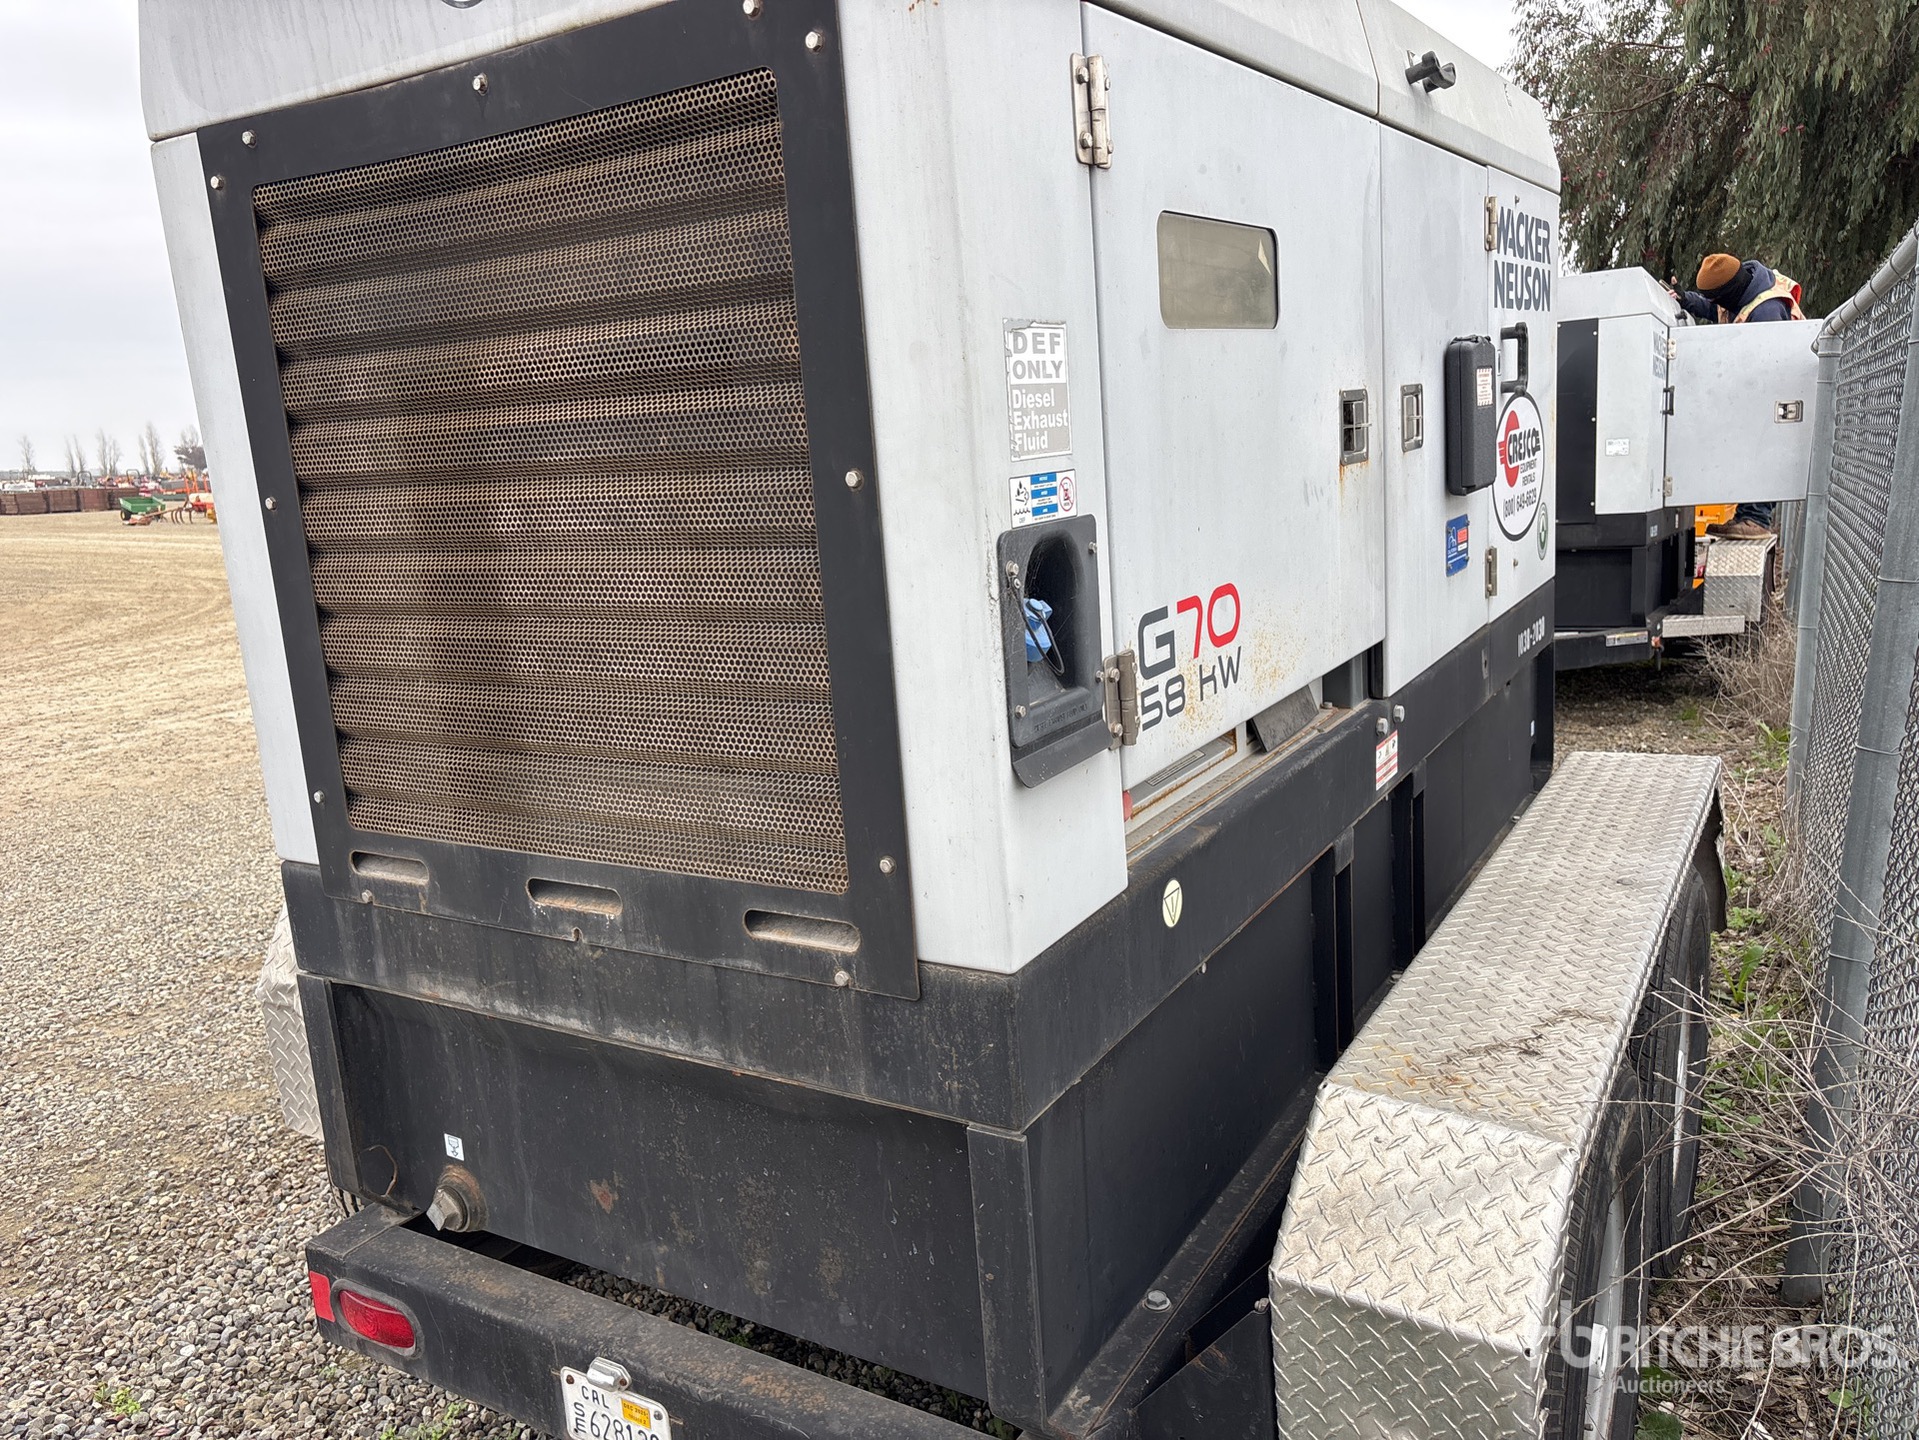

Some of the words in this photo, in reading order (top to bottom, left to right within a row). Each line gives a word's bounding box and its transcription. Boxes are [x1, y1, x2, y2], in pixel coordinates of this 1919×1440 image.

[1497, 206, 1551, 264] WACKER
[1494, 259, 1551, 312] NEUSON
[1012, 331, 1061, 354] DEF
[1012, 360, 1063, 379] ONLY
[1012, 388, 1055, 408] Diesel
[1013, 409, 1069, 430] Exhaust
[1014, 431, 1049, 451] Fluid
[1508, 427, 1541, 465] CRESCO
[1138, 582, 1241, 680] G70
[1141, 674, 1186, 732] 58
[581, 1385, 610, 1410] CAL
[590, 1410, 661, 1440] 6281
